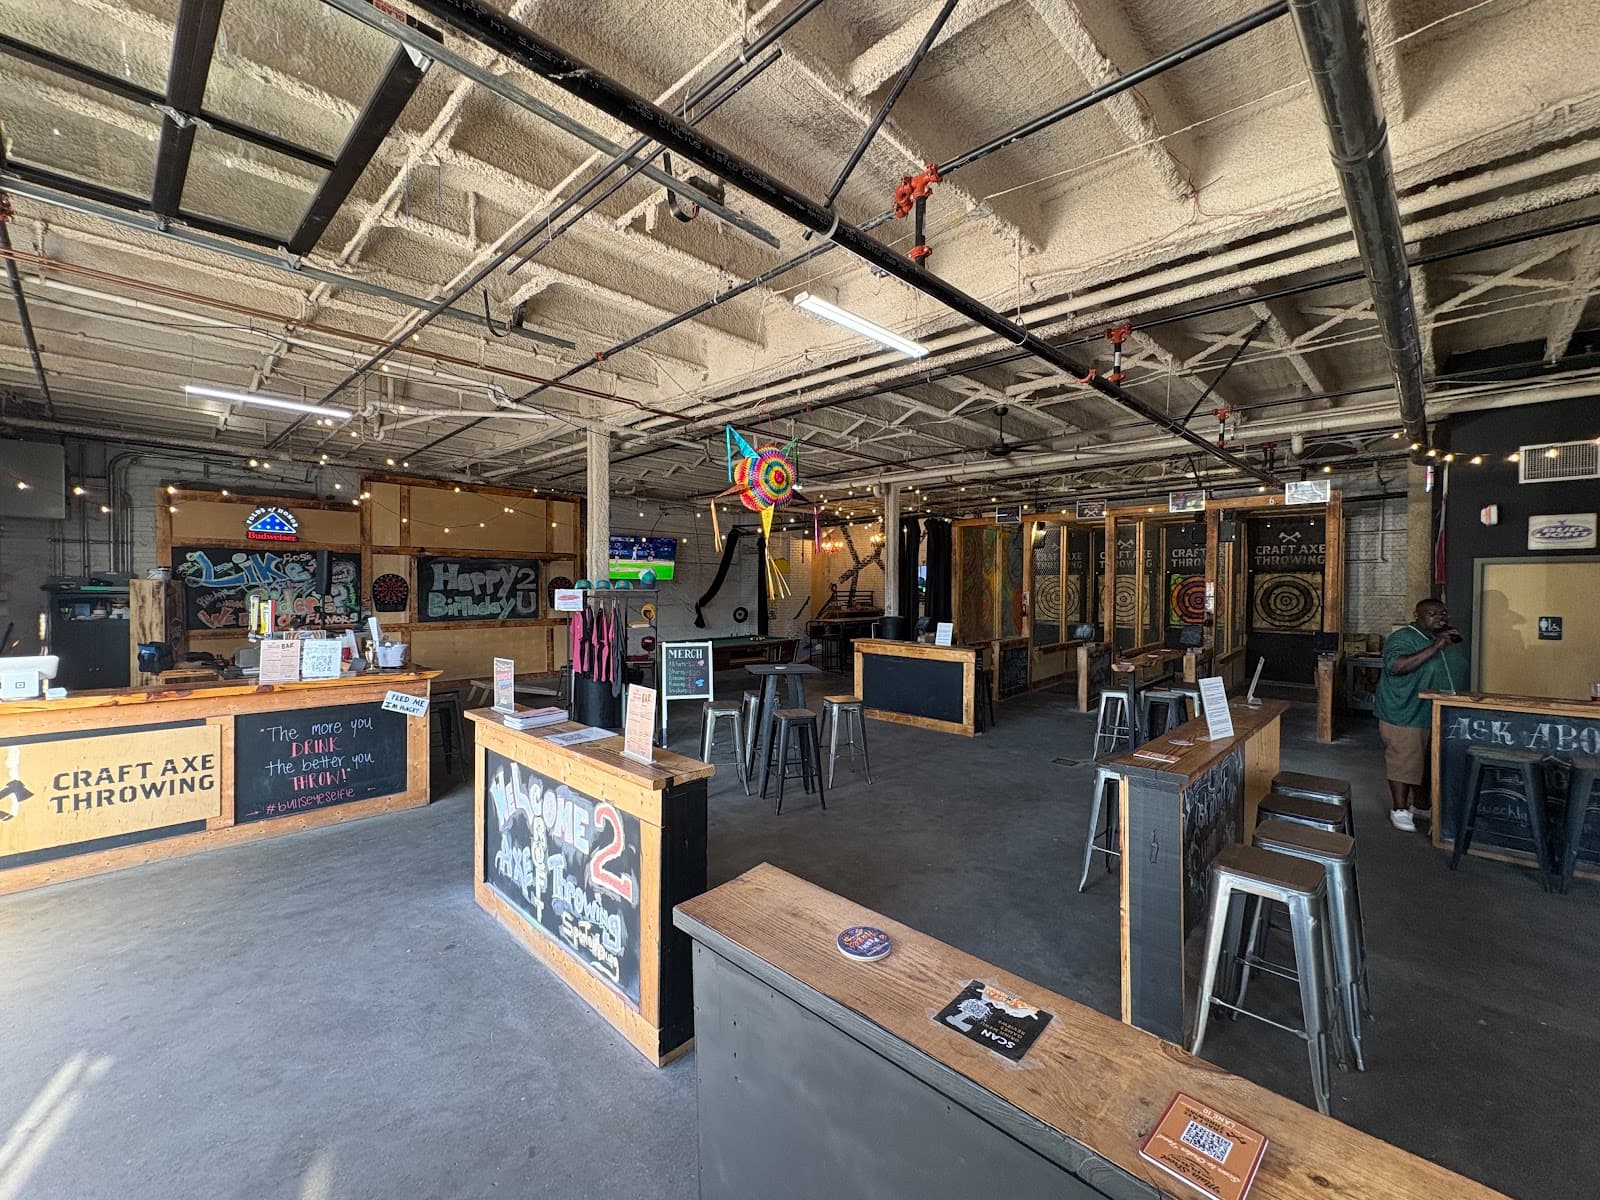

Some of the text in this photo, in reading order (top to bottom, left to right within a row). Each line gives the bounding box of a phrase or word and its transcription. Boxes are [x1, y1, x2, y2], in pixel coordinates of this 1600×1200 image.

[1269, 495, 1275, 505] 6
[248, 531, 297, 541] Budweiser
[1256, 543, 1325, 555] CRAFT AXE
[1099, 558, 1153, 568] TOWG
[1171, 558, 1206, 567] THRO
[1254, 555, 1325, 565] THROWING
[516, 568, 537, 590] 2
[516, 591, 537, 614] U
[669, 649, 703, 659] MERCH
[412, 699, 425, 707] ME
[311, 721, 343, 735] more
[350, 716, 373, 737] you
[1448, 717, 1515, 746] ASK
[291, 736, 343, 757] DRINK
[53, 753, 215, 792] CRAFT AXE
[265, 751, 375, 776] the better you
[50, 774, 215, 814] THROWING
[265, 788, 356, 816] #bullseyeselfie
[592, 802, 633, 903] 2
[980, 1029, 1016, 1049] SCAN
[1185, 1106, 1225, 1131] THROWING
[1212, 1112, 1236, 1129] LANE
[1156, 1133, 1179, 1149] Food
[1160, 1154, 1191, 1173] Street
[1181, 1147, 1206, 1164] Order
[1207, 1161, 1217, 1169] to
[1192, 1171, 1221, 1194] Main
[1218, 1167, 1241, 1183] Scan
